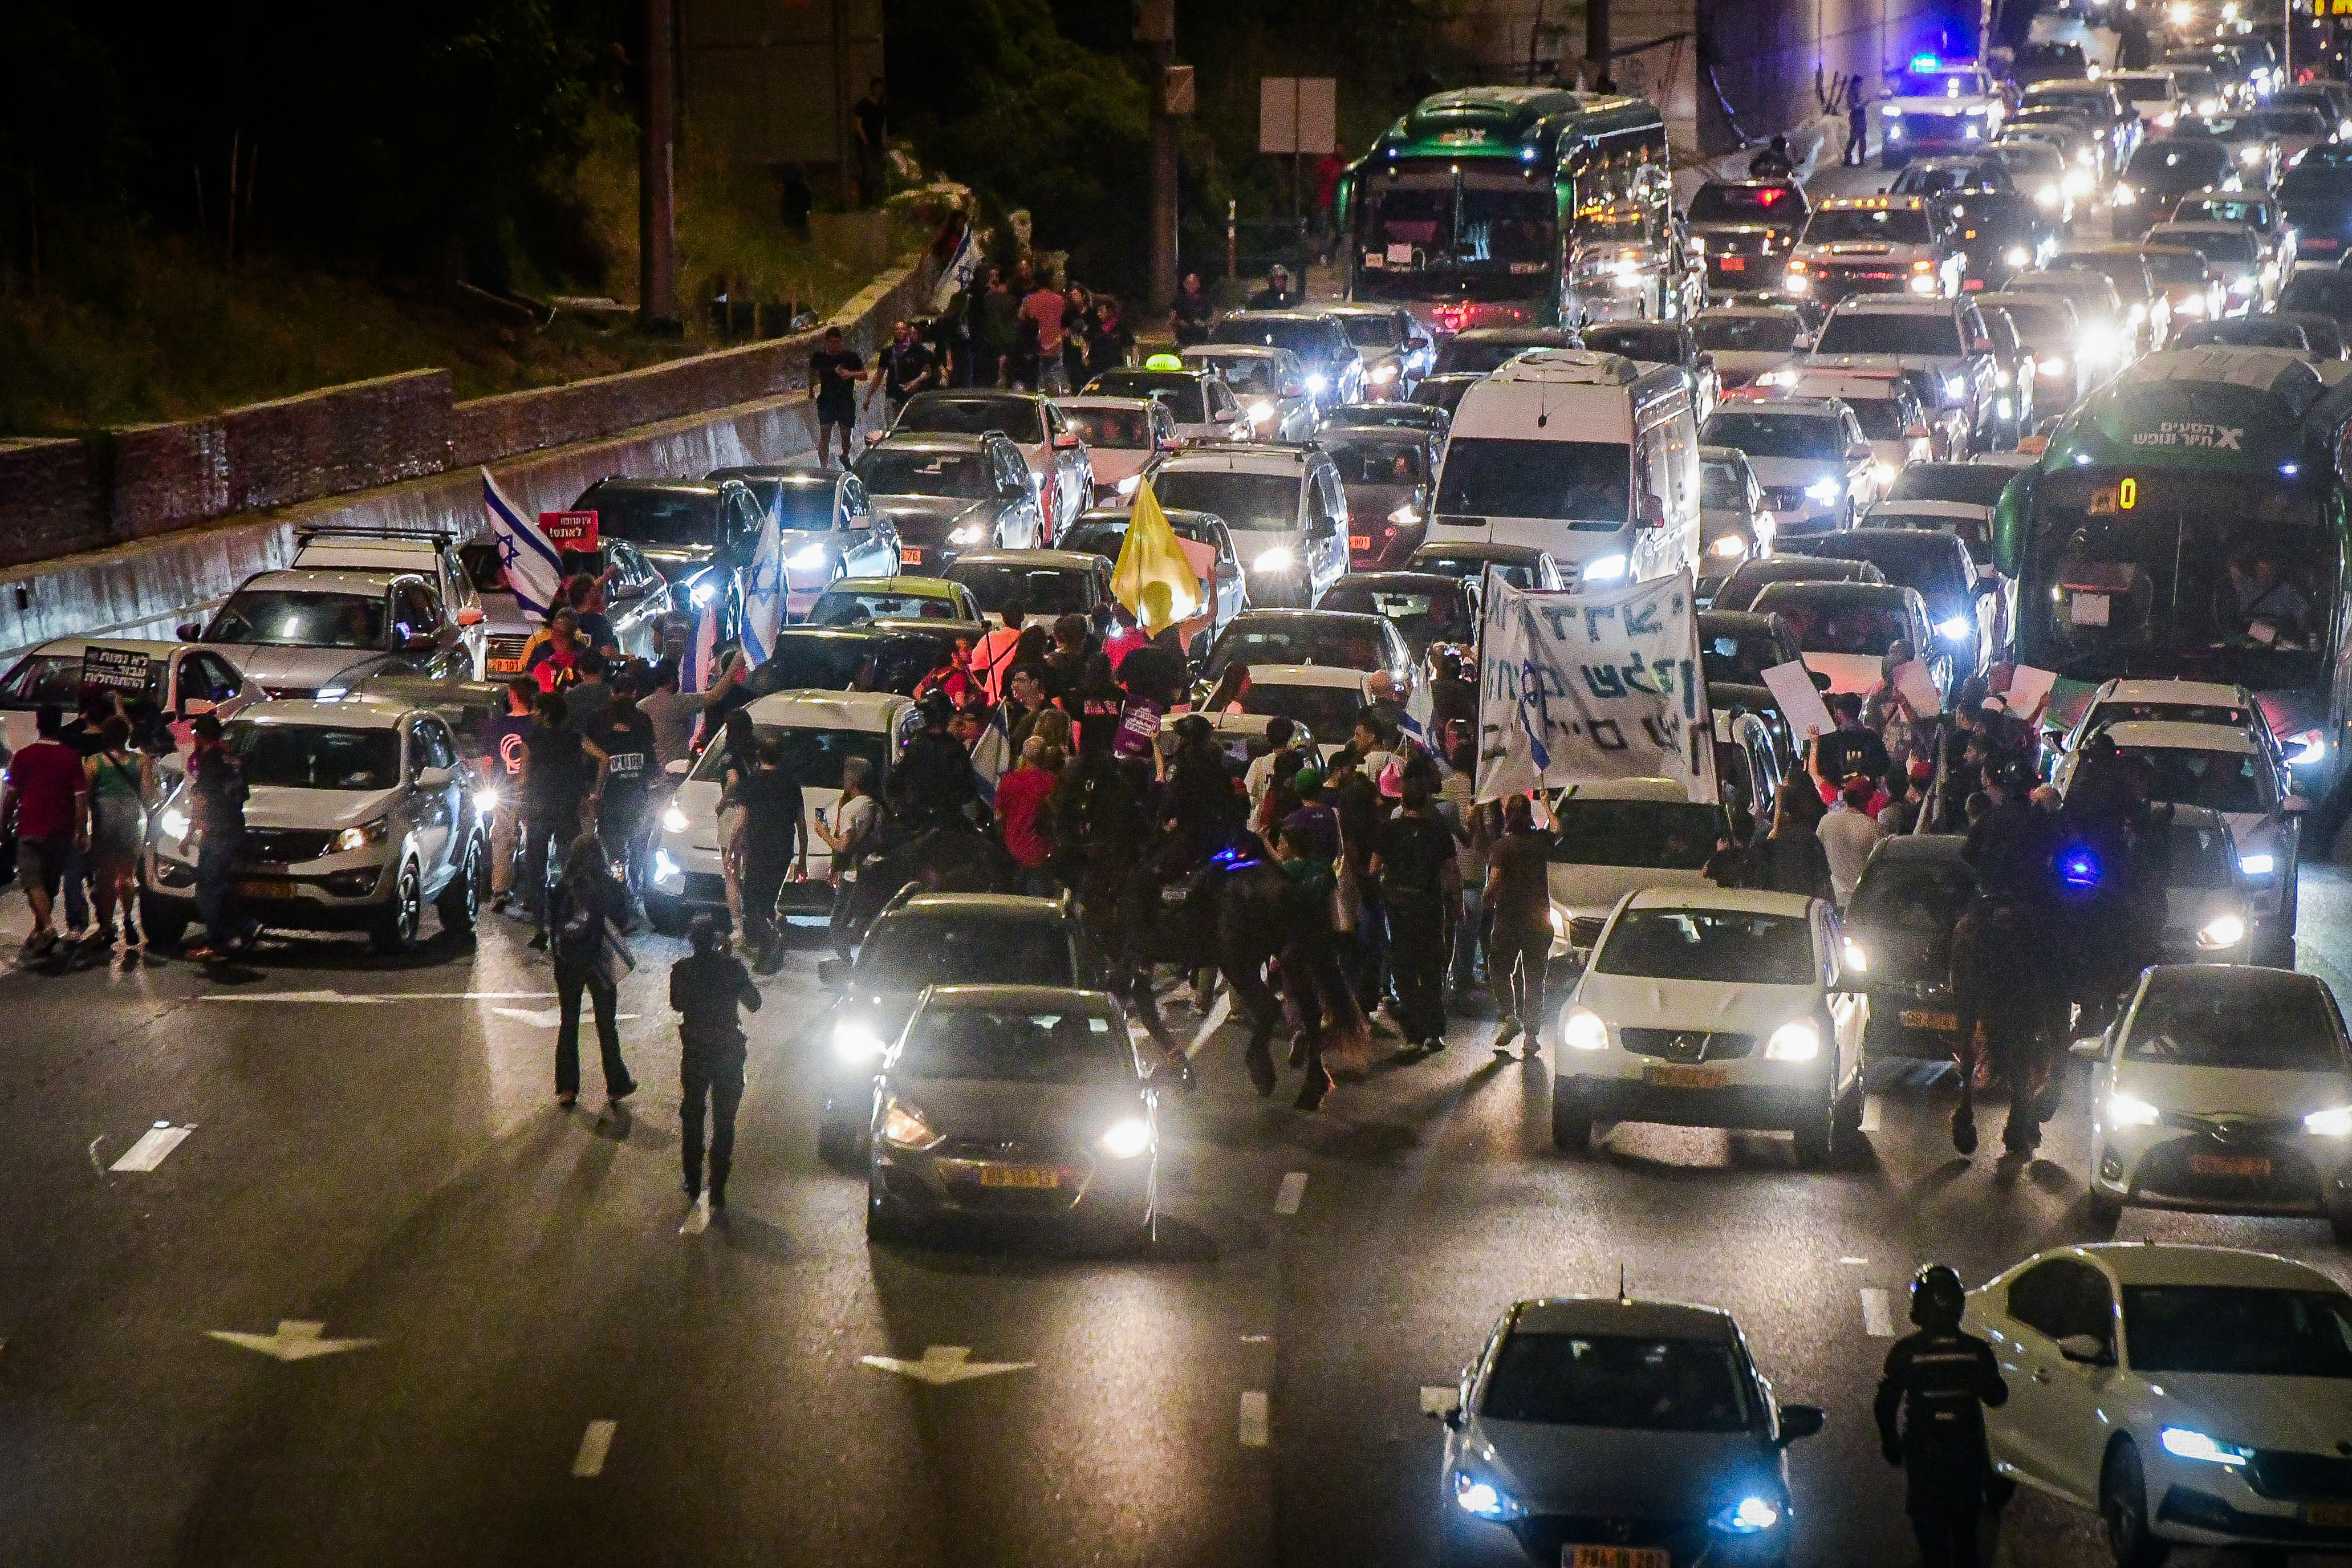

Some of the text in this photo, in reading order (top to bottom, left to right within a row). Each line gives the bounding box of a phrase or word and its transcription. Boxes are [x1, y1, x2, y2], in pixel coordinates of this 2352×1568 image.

[2160, 421, 2215, 434] הסעים
[2132, 432, 2177, 445] ונופש
[2120, 478, 2136, 509] 0
